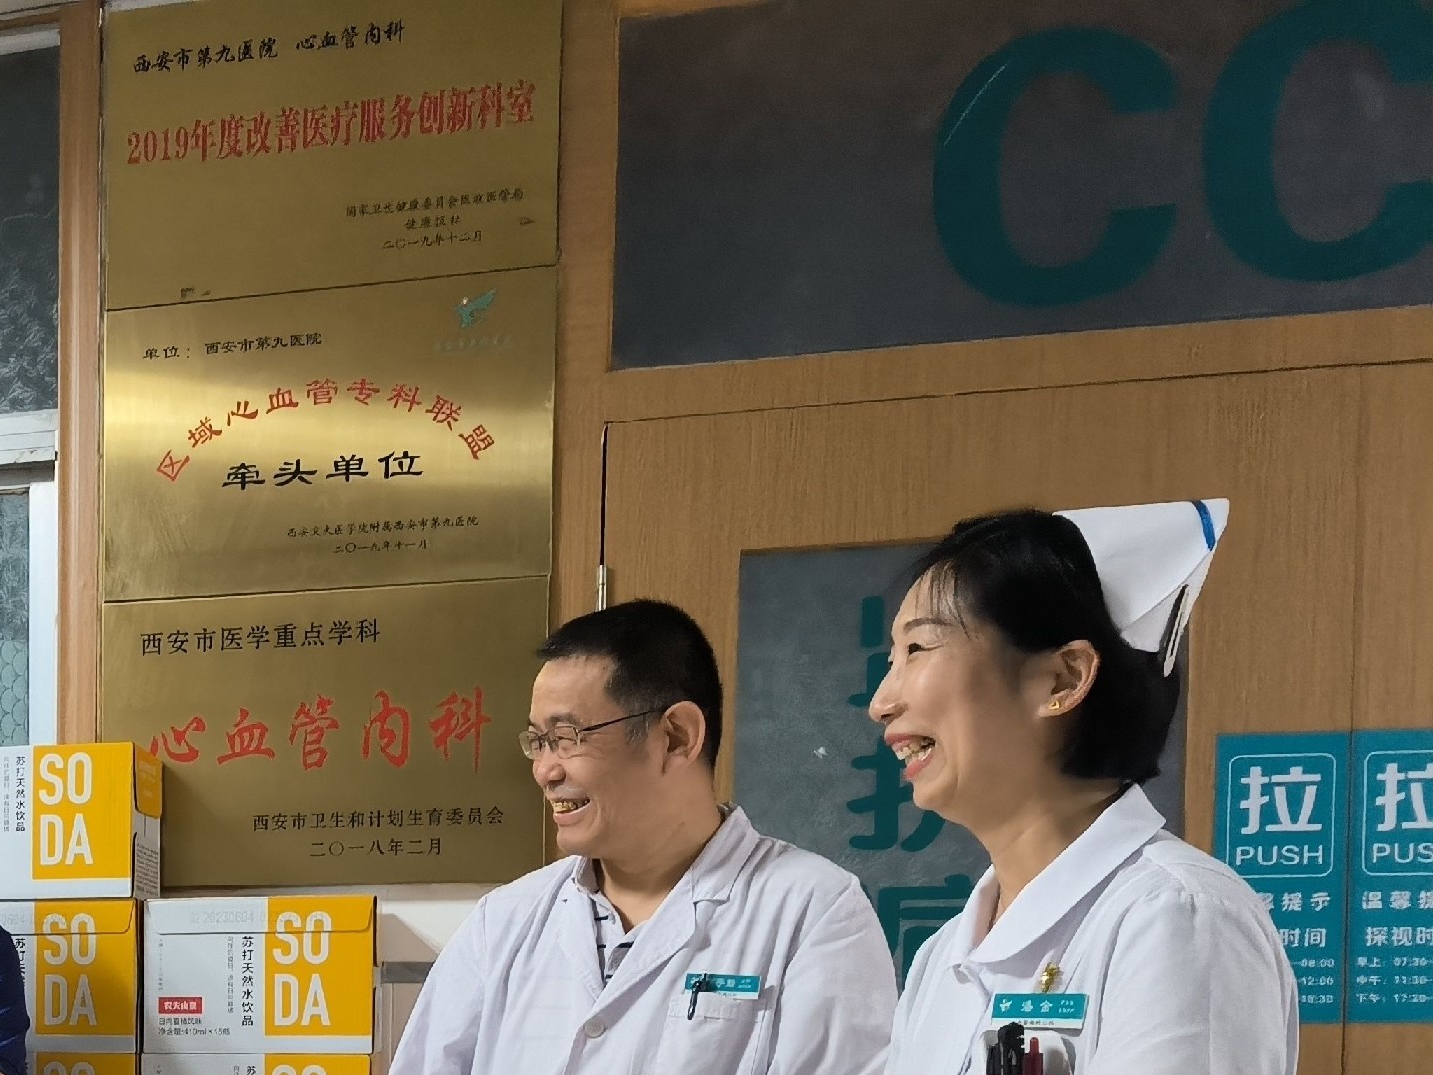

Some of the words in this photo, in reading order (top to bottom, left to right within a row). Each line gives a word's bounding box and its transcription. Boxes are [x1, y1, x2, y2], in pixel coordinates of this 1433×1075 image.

[133, 37, 279, 74] 西安市第九医院
[296, 19, 405, 51] 心血管内科
[127, 79, 536, 164] 2019年度改善医疗服务创新科室
[205, 332, 322, 356] 西安市第九医院
[156, 378, 495, 482] 区域心血管专科联盟
[222, 450, 423, 491] 牵头单位
[140, 618, 380, 657] 西安市医学重点学科
[149, 686, 495, 774] 心血管内科
[16, 756, 25, 831] 苏打天然水饮品
[39, 752, 92, 805] SO
[1239, 766, 1323, 835] 拉
[1376, 763, 1433, 832] 拉
[40, 814, 93, 866] DA
[253, 805, 504, 832] 西安市卫生和计划生育委员会
[1235, 844, 1323, 866] PUSH
[42, 913, 96, 965] SO
[273, 910, 332, 965] SO
[43, 974, 97, 1026] DA
[241, 936, 254, 1026] 苏打天然水饮品
[274, 973, 331, 1027] DA
